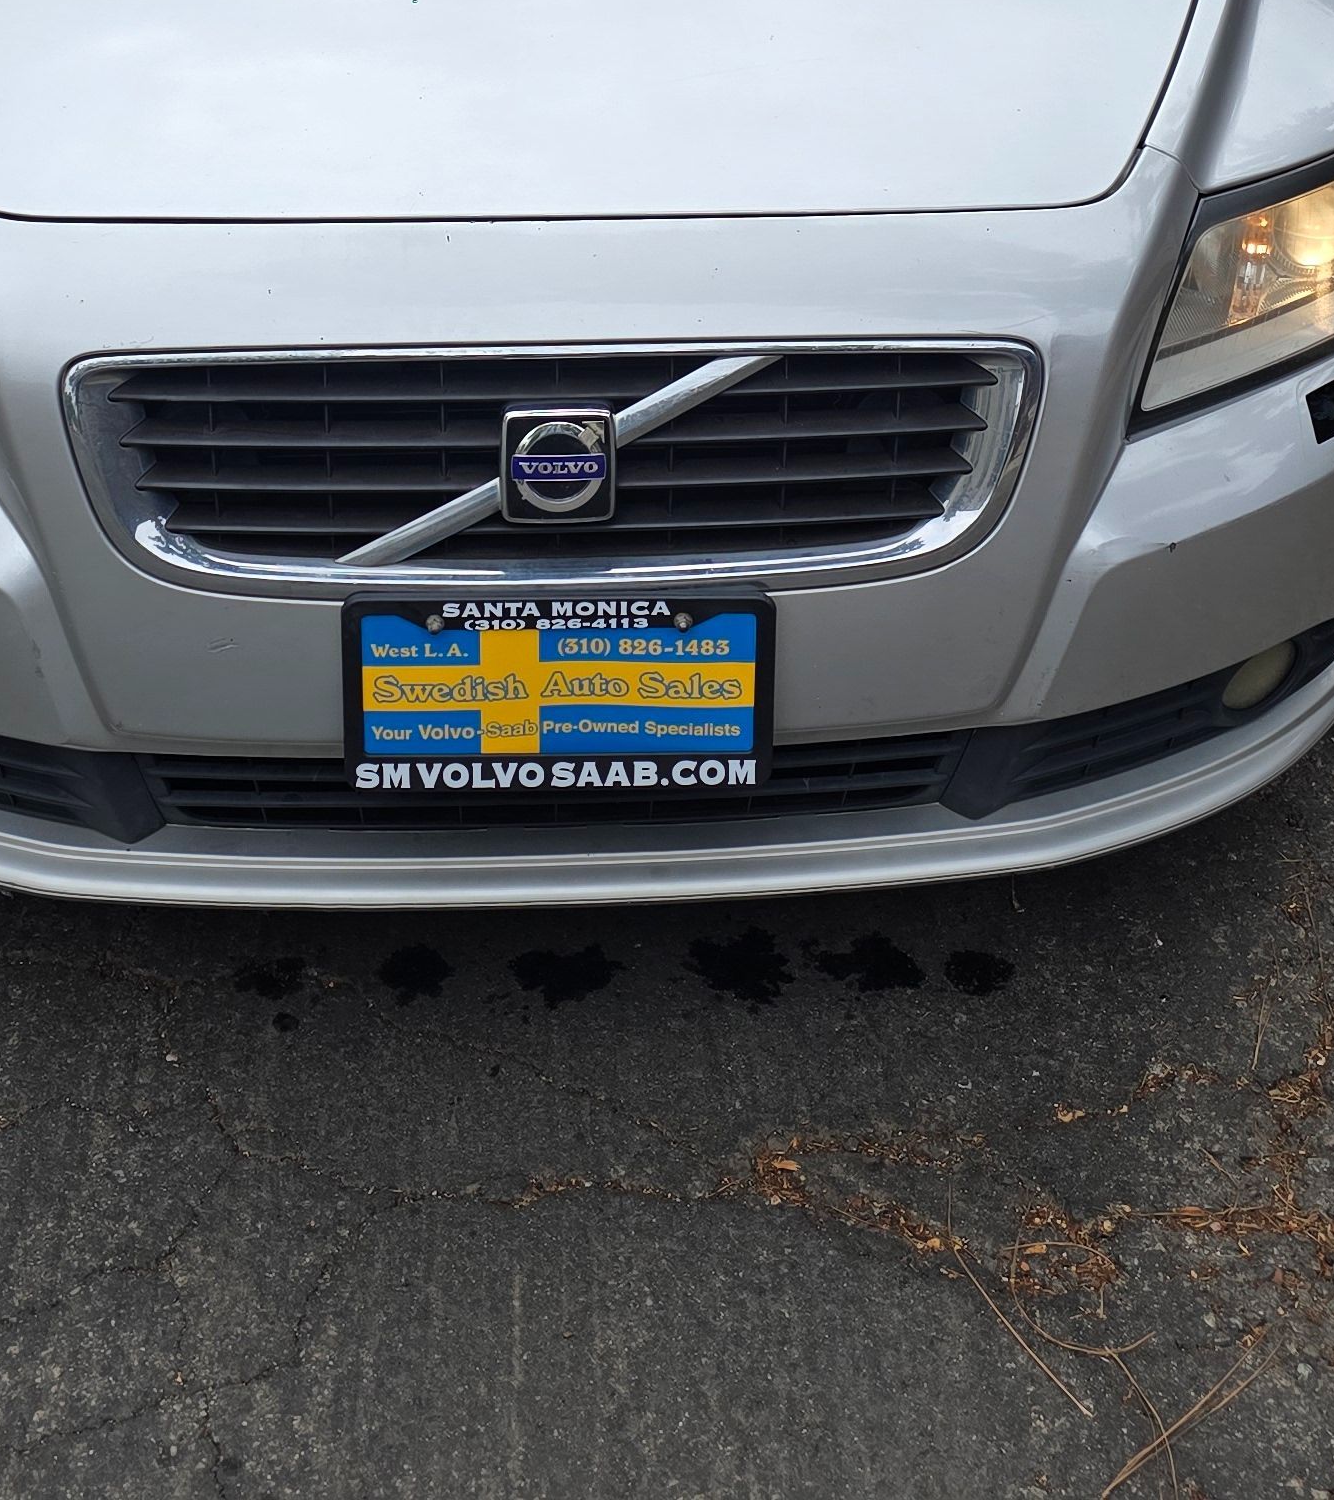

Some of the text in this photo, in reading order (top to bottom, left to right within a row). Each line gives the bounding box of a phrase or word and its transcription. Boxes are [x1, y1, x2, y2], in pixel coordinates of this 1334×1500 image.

[519, 461, 599, 474] VOLVO
[442, 600, 671, 619] SANTA MONICA
[464, 617, 649, 631] (310) 826-4113
[370, 643, 418, 658] West
[557, 638, 730, 657] (310) 826-1483
[373, 671, 743, 703] Swedish Auto Sales
[371, 725, 413, 741] Your
[542, 719, 640, 735] Pre-Owned
[644, 720, 741, 737] Specialists
